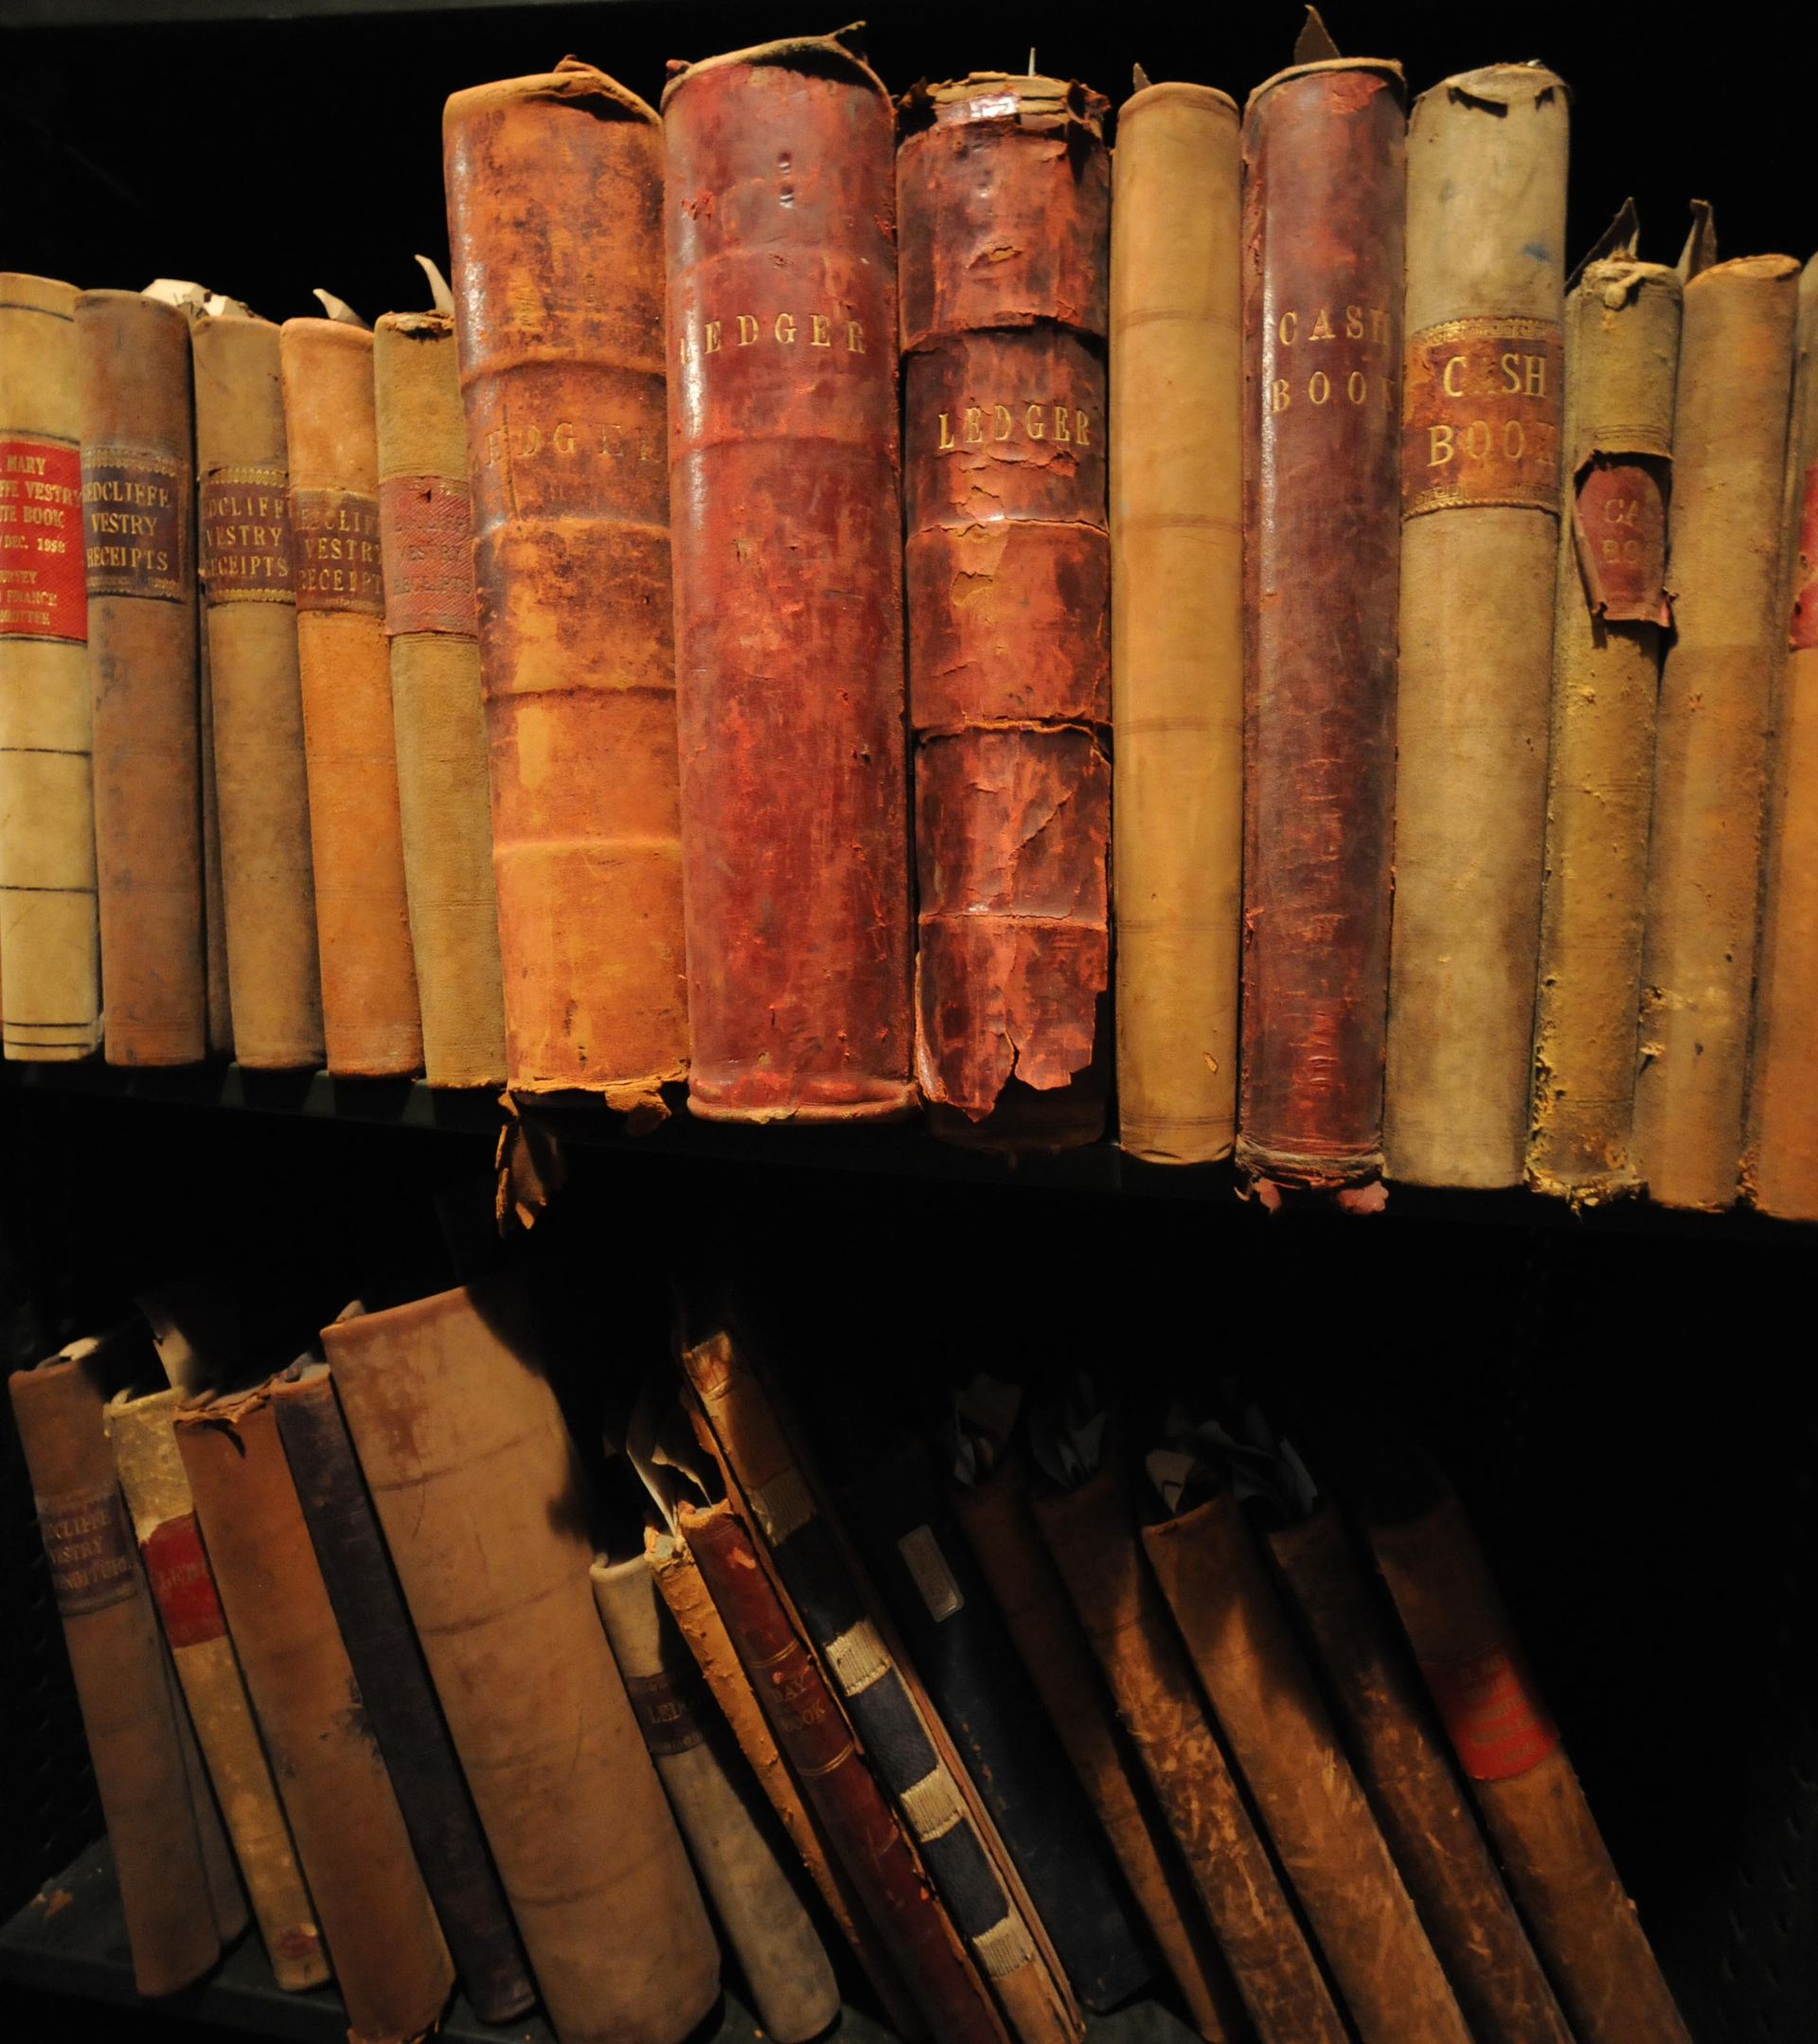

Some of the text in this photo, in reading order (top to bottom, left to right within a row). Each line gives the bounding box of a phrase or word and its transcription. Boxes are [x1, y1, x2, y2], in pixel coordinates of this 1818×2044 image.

[1443, 353, 1546, 399] CSH
[938, 404, 1091, 450] LEDGER
[7, 454, 46, 476] MARY
[23, 506, 65, 528] BOOK
[91, 505, 159, 537] VESTRY
[87, 545, 169, 571] RECEIPTS
